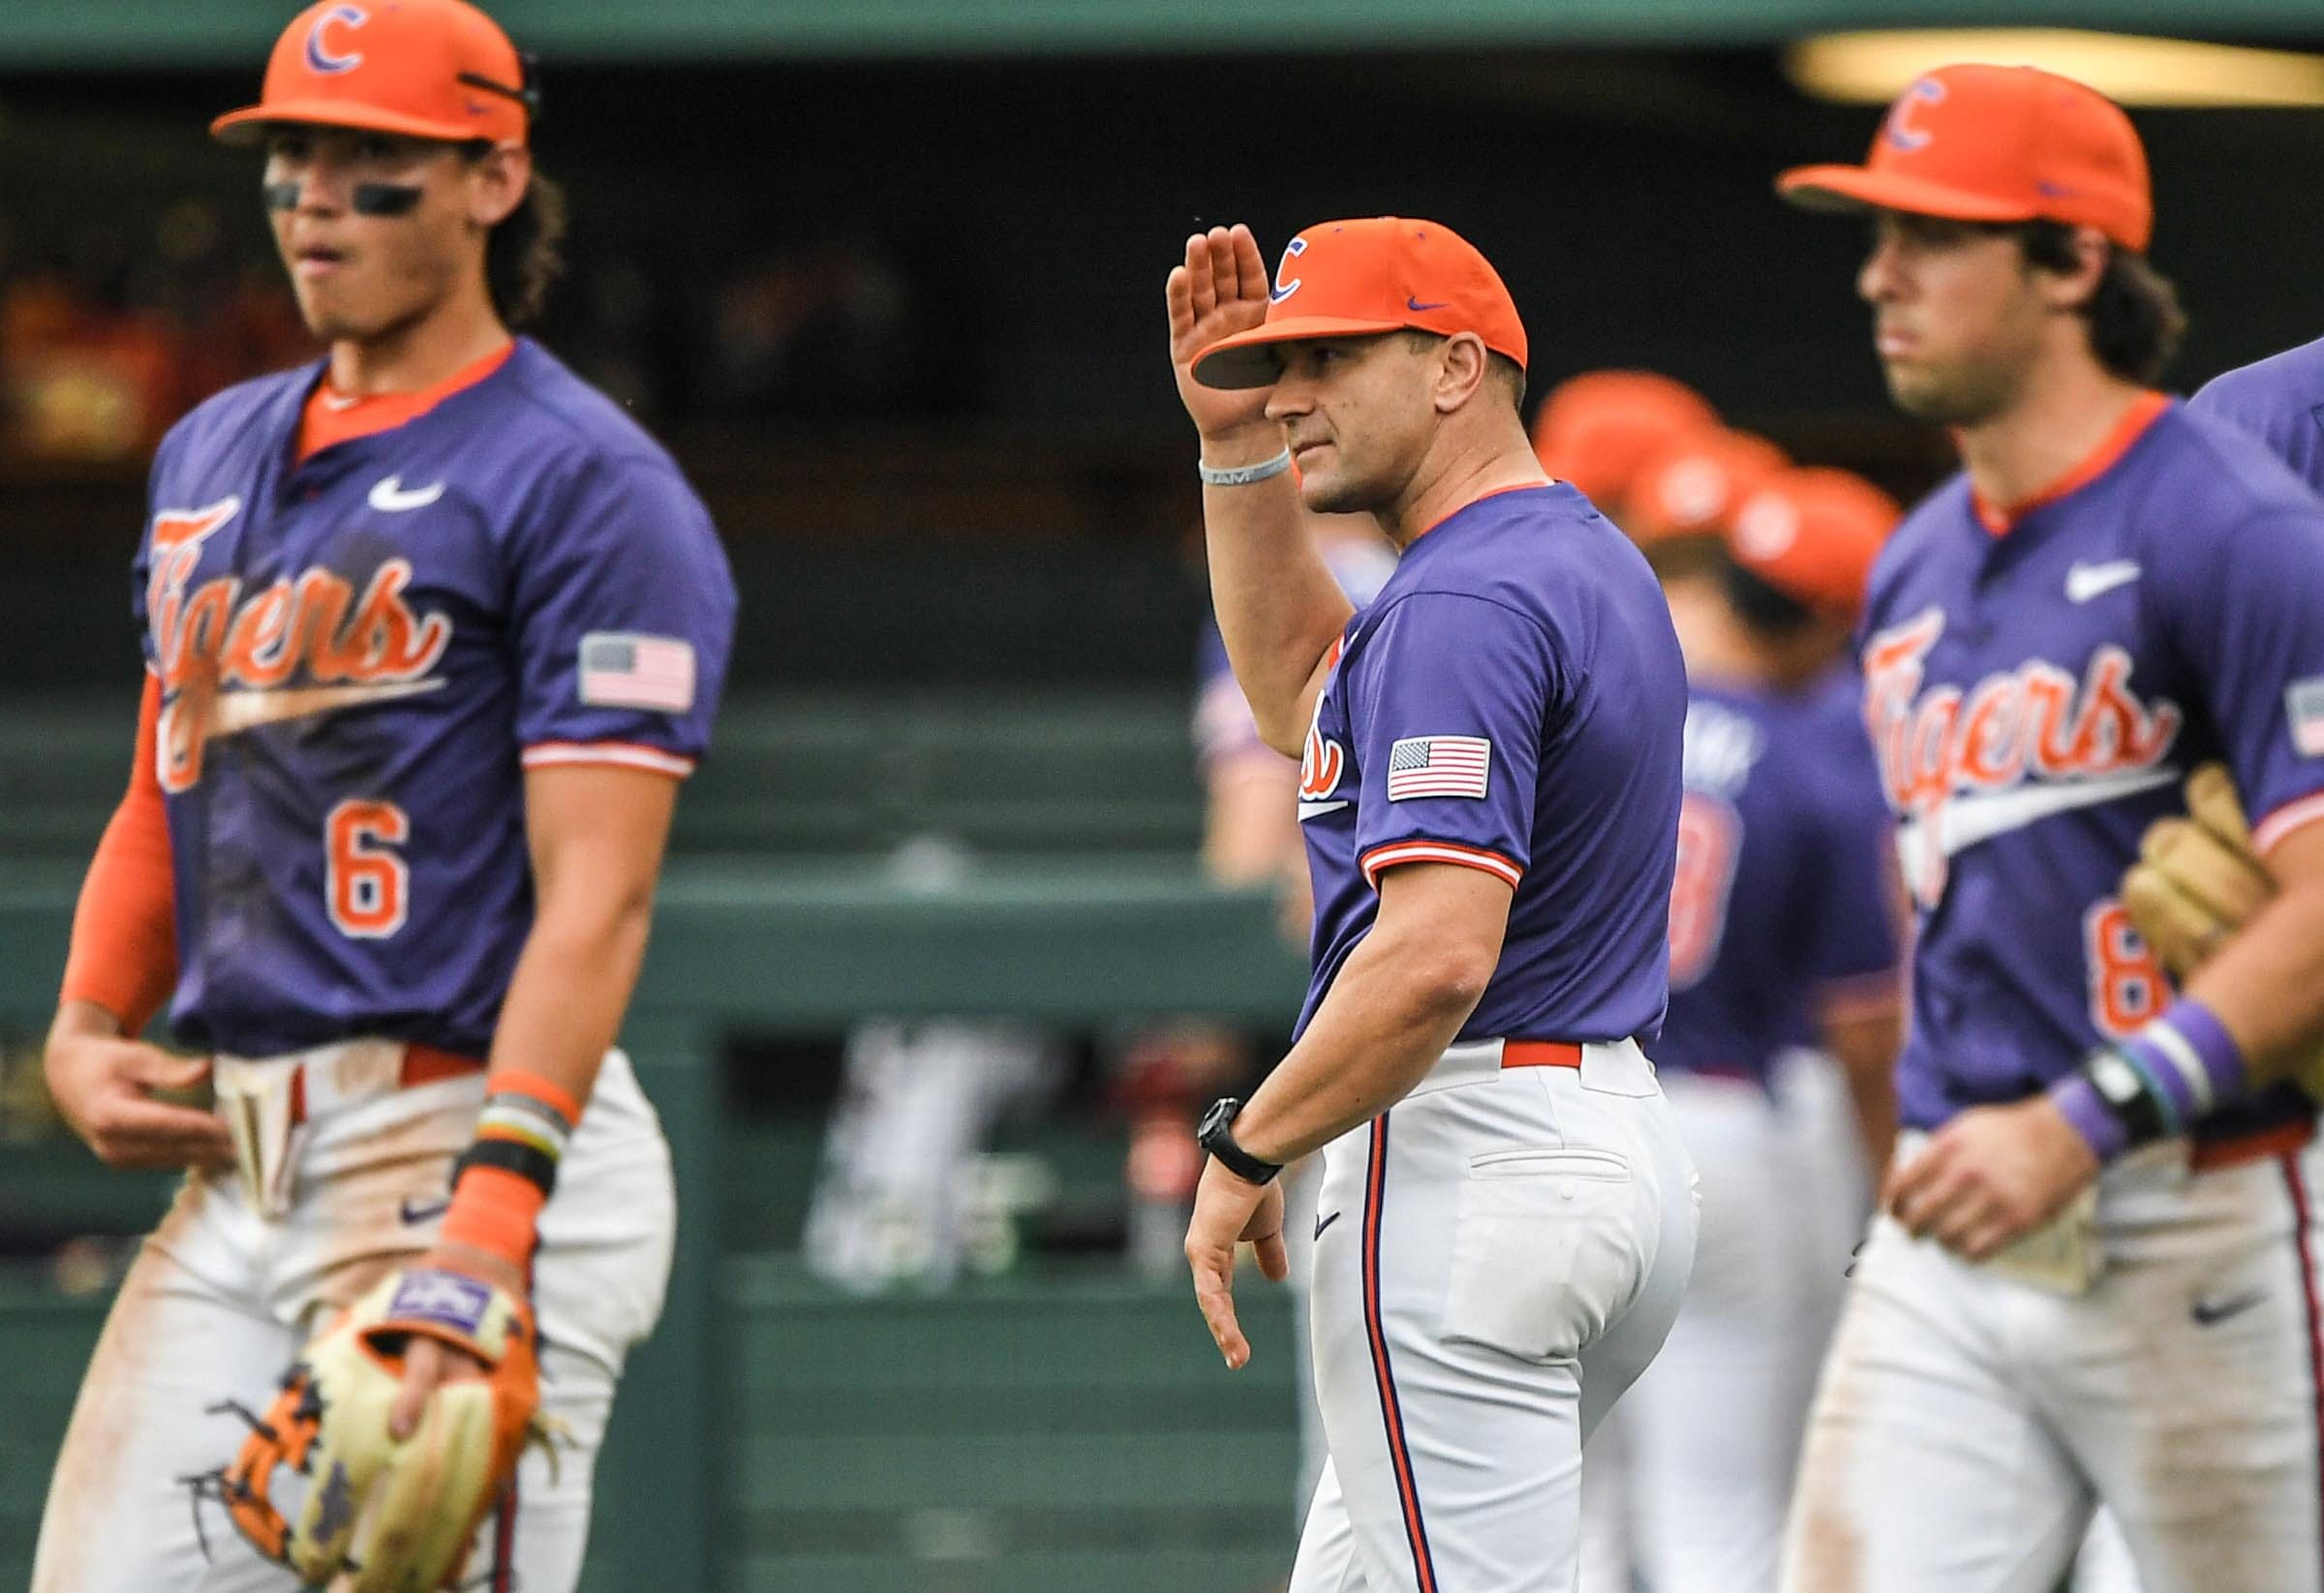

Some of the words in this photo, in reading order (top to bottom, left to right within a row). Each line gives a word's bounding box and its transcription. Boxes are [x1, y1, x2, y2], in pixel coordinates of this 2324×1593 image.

[305, 4, 370, 76] C
[1886, 76, 1947, 152] C
[1269, 236, 1309, 304] C
[147, 496, 452, 793] Tigers
[1862, 608, 2183, 909] Tigers
[325, 798, 409, 939] 6
